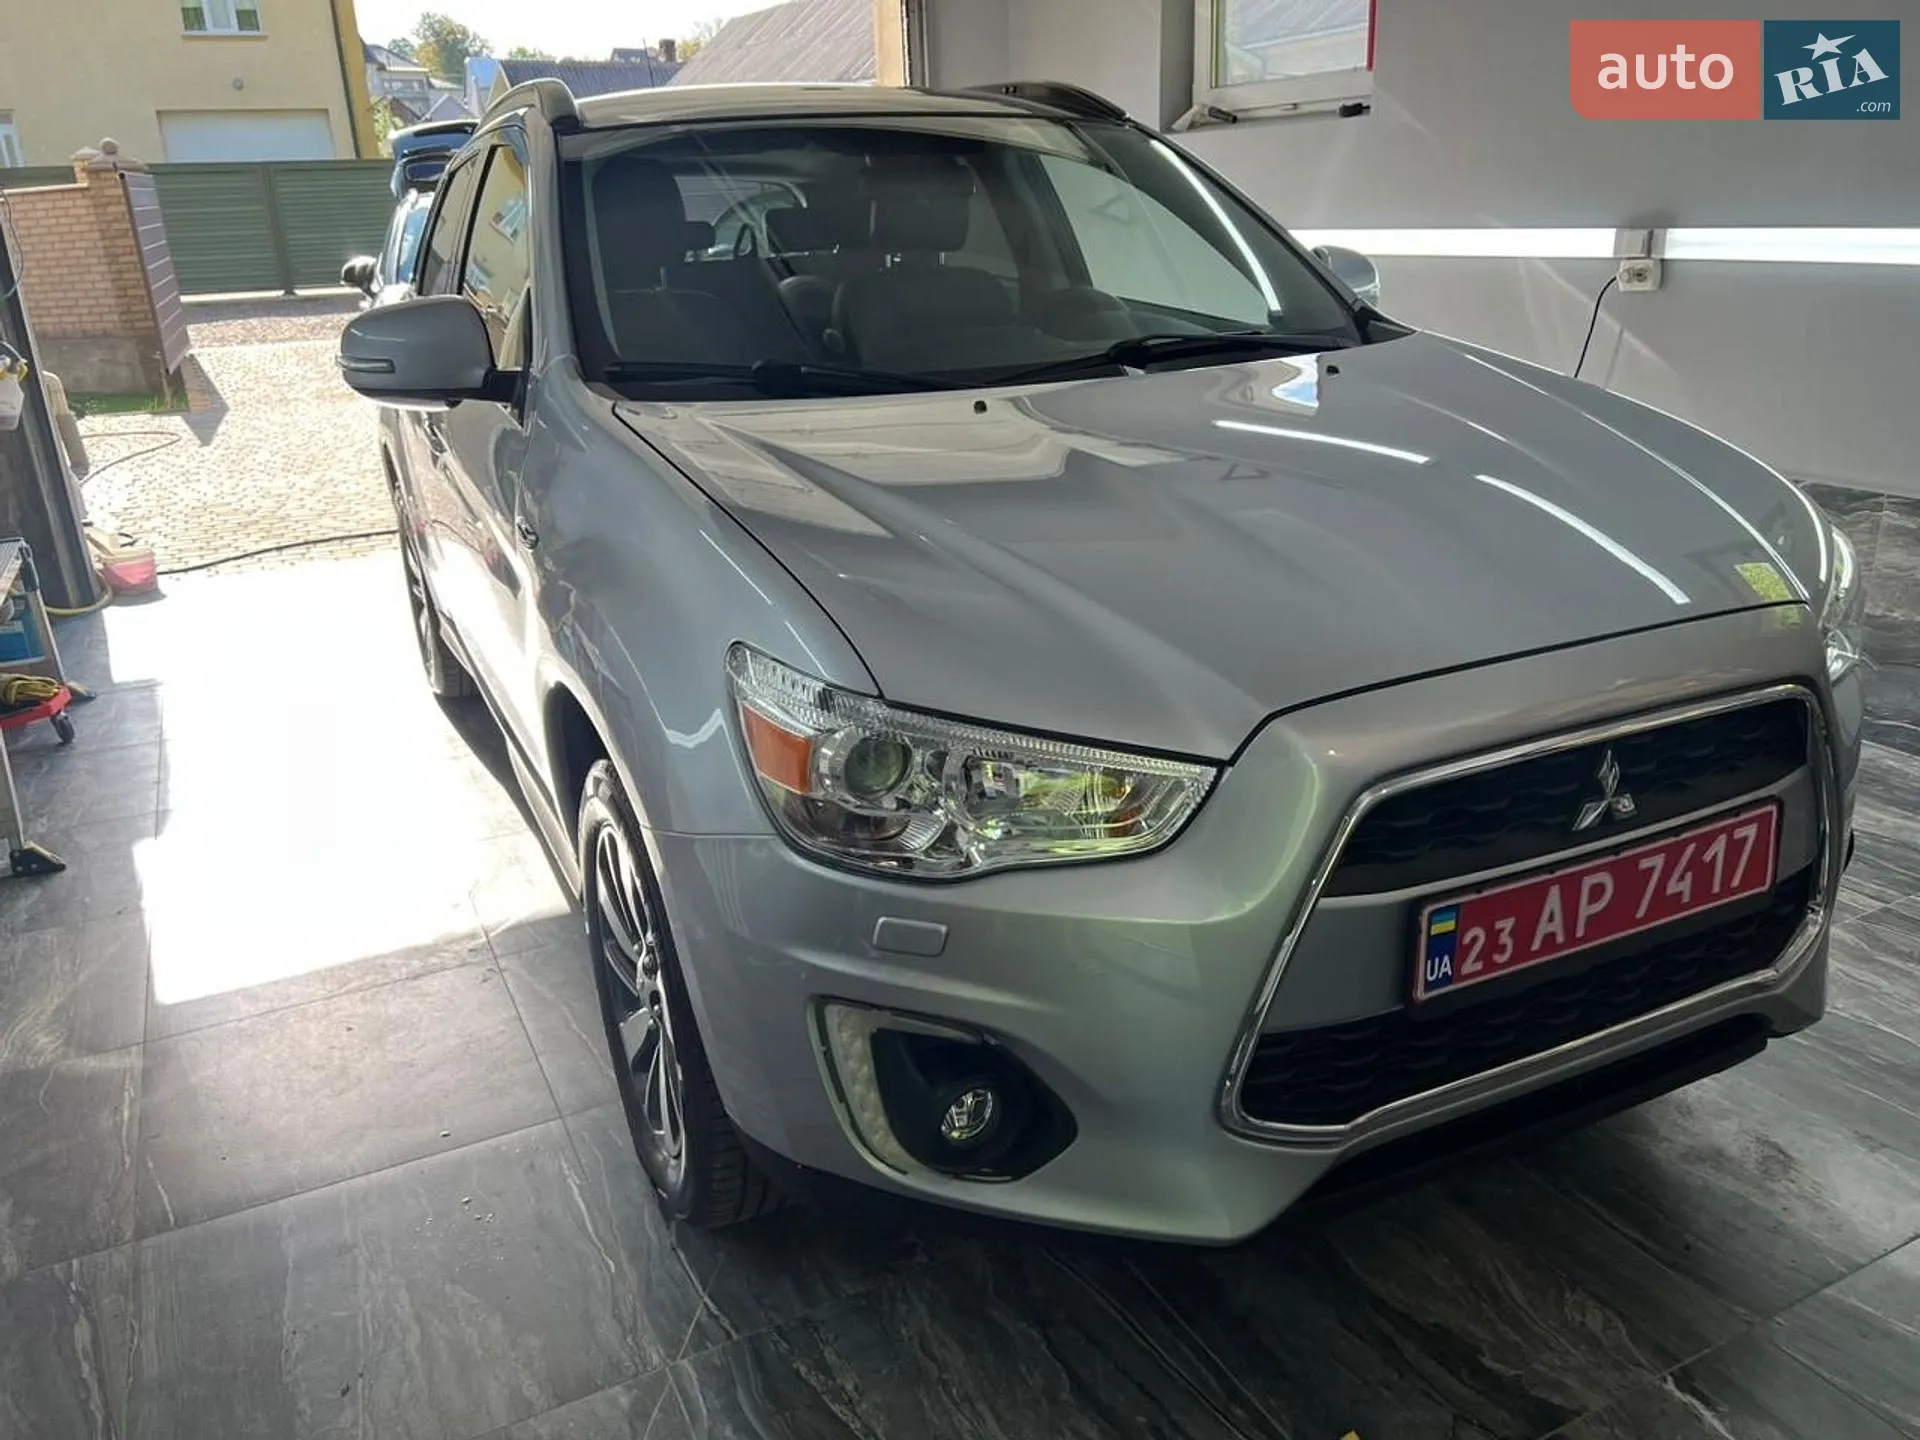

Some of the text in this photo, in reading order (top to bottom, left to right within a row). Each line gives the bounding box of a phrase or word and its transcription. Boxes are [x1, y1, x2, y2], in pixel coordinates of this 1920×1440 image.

[1460, 822, 1760, 976] 23 AP 7417
[1426, 953, 1453, 983] UA
